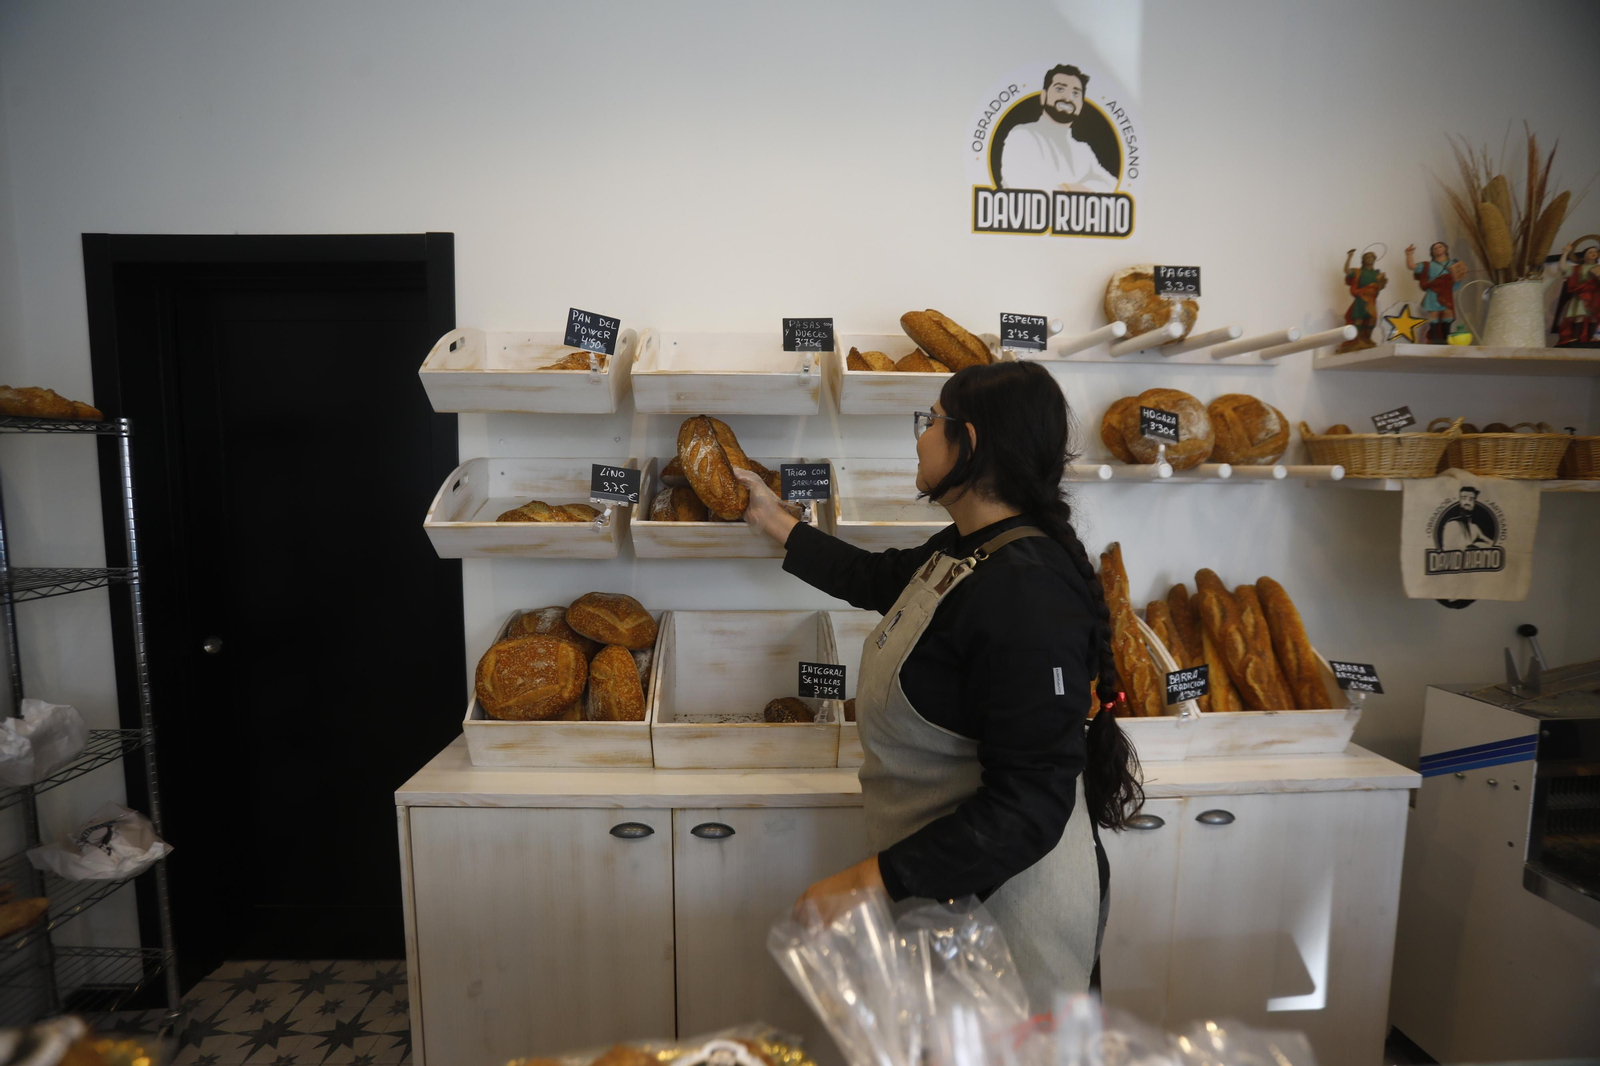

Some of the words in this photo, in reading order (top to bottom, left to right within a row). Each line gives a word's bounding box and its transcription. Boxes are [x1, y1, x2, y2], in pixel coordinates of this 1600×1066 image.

[972, 84, 1020, 153] OBRADOR
[1106, 100, 1139, 179] ARTESANO
[977, 191, 1047, 230] DAVID
[1055, 194, 1130, 233] RUANO
[572, 309, 591, 324] PAN
[599, 318, 617, 330] DEL
[789, 320, 820, 329] PASAS
[1002, 314, 1045, 326] ESPELTA
[573, 322, 611, 339] POWER
[795, 329, 828, 338] NUECES
[1143, 408, 1176, 424] HOGAZA
[1489, 501, 1508, 541] ARTESANO
[1429, 551, 1460, 571] DAVID
[801, 664, 843, 677] INTEGRAL
[1332, 663, 1367, 674] BARRA
[1169, 669, 1199, 685] BARRA
